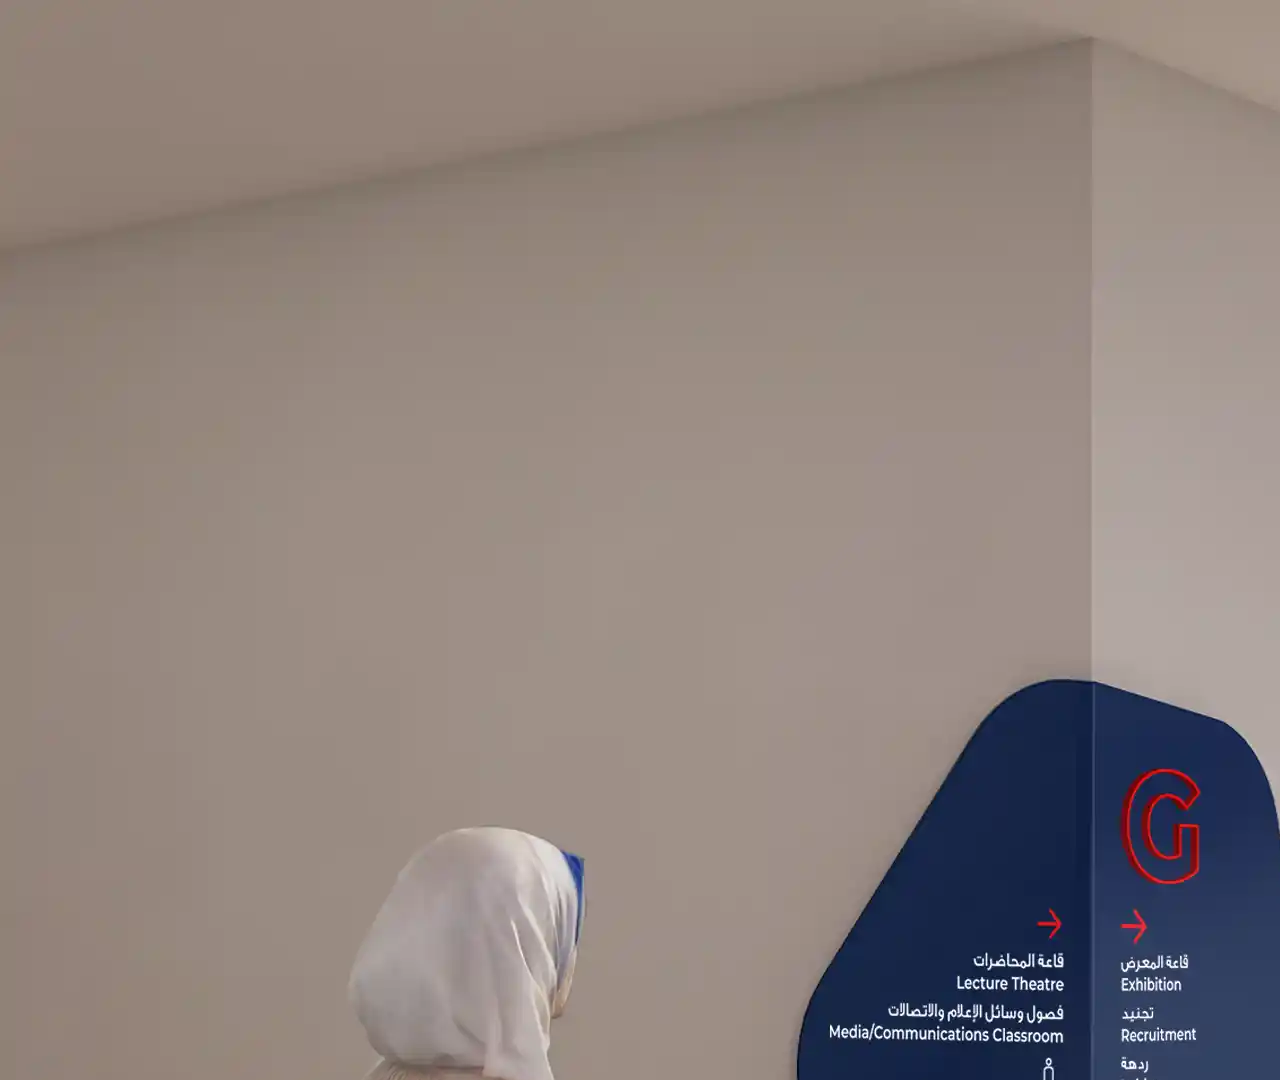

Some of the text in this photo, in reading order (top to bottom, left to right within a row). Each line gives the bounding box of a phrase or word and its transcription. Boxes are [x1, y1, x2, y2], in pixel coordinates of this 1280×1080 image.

[1121, 768, 1200, 884] G
[974, 953, 1064, 970] قاعة المحاضرات
[1121, 954, 1188, 972] قاعة المعرض
[957, 976, 1064, 991] Lecture Theatre
[1121, 977, 1181, 991] Exhibition
[888, 1003, 1063, 1023] فصول وسائل الإعلام والاتصالات
[1122, 1008, 1153, 1022] تجنيد
[829, 1024, 1063, 1043] Media/Communications Classroom
[1122, 1027, 1196, 1042] Recruitment
[1121, 1057, 1148, 1073] ردهة
